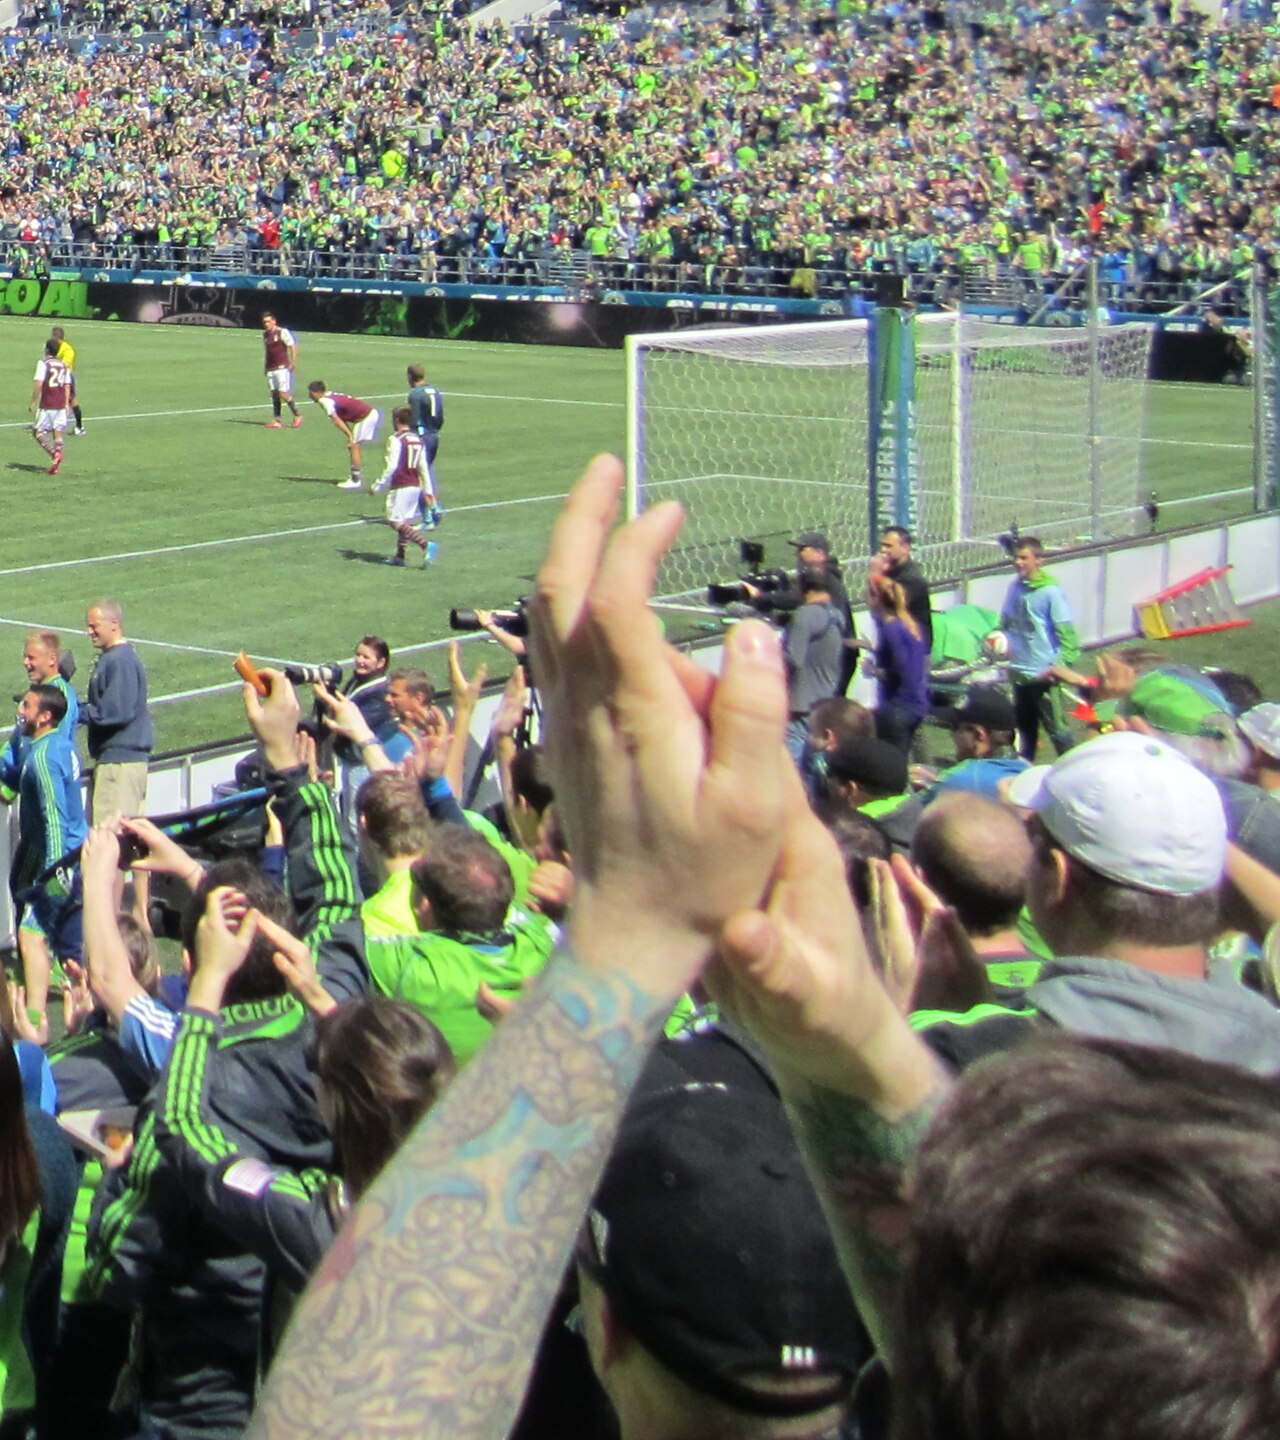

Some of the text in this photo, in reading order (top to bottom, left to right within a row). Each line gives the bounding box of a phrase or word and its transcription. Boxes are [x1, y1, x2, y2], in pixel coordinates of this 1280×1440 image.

[48, 367, 66, 389] 24
[429, 393, 436, 417] 1
[407, 443, 422, 469] 17
[876, 436, 898, 527] UNDERS
